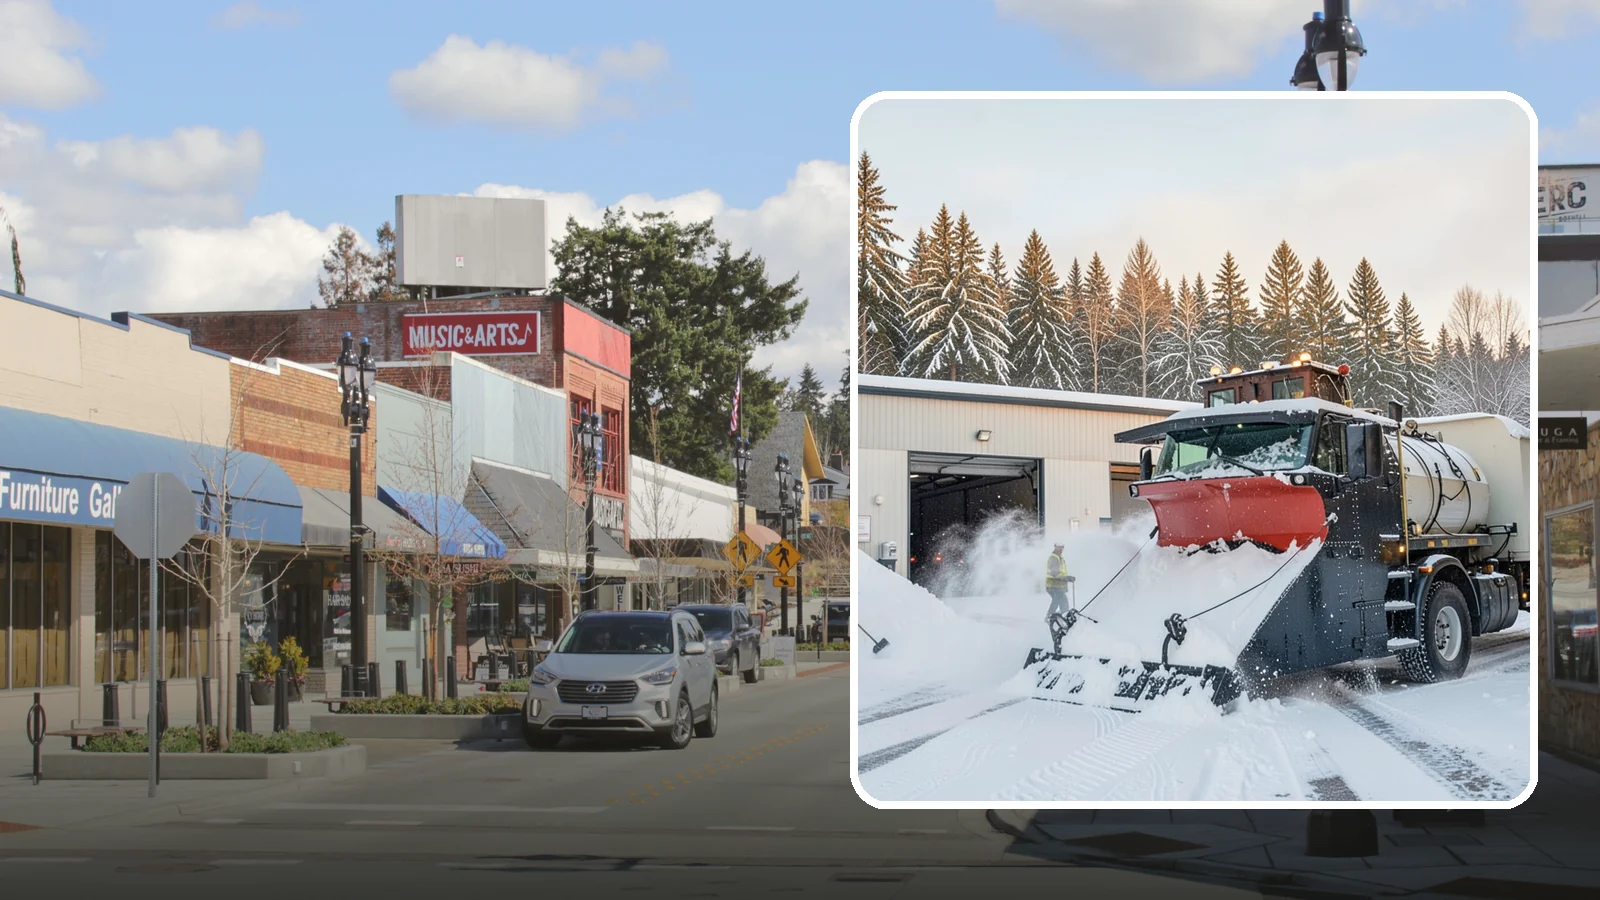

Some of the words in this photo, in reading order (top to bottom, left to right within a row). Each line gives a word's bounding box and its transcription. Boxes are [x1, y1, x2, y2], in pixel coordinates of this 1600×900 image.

[409, 323, 520, 349] MUSIC&ARTS
[0, 471, 79, 515] Furniture
[453, 563, 479, 574] SUSHI
